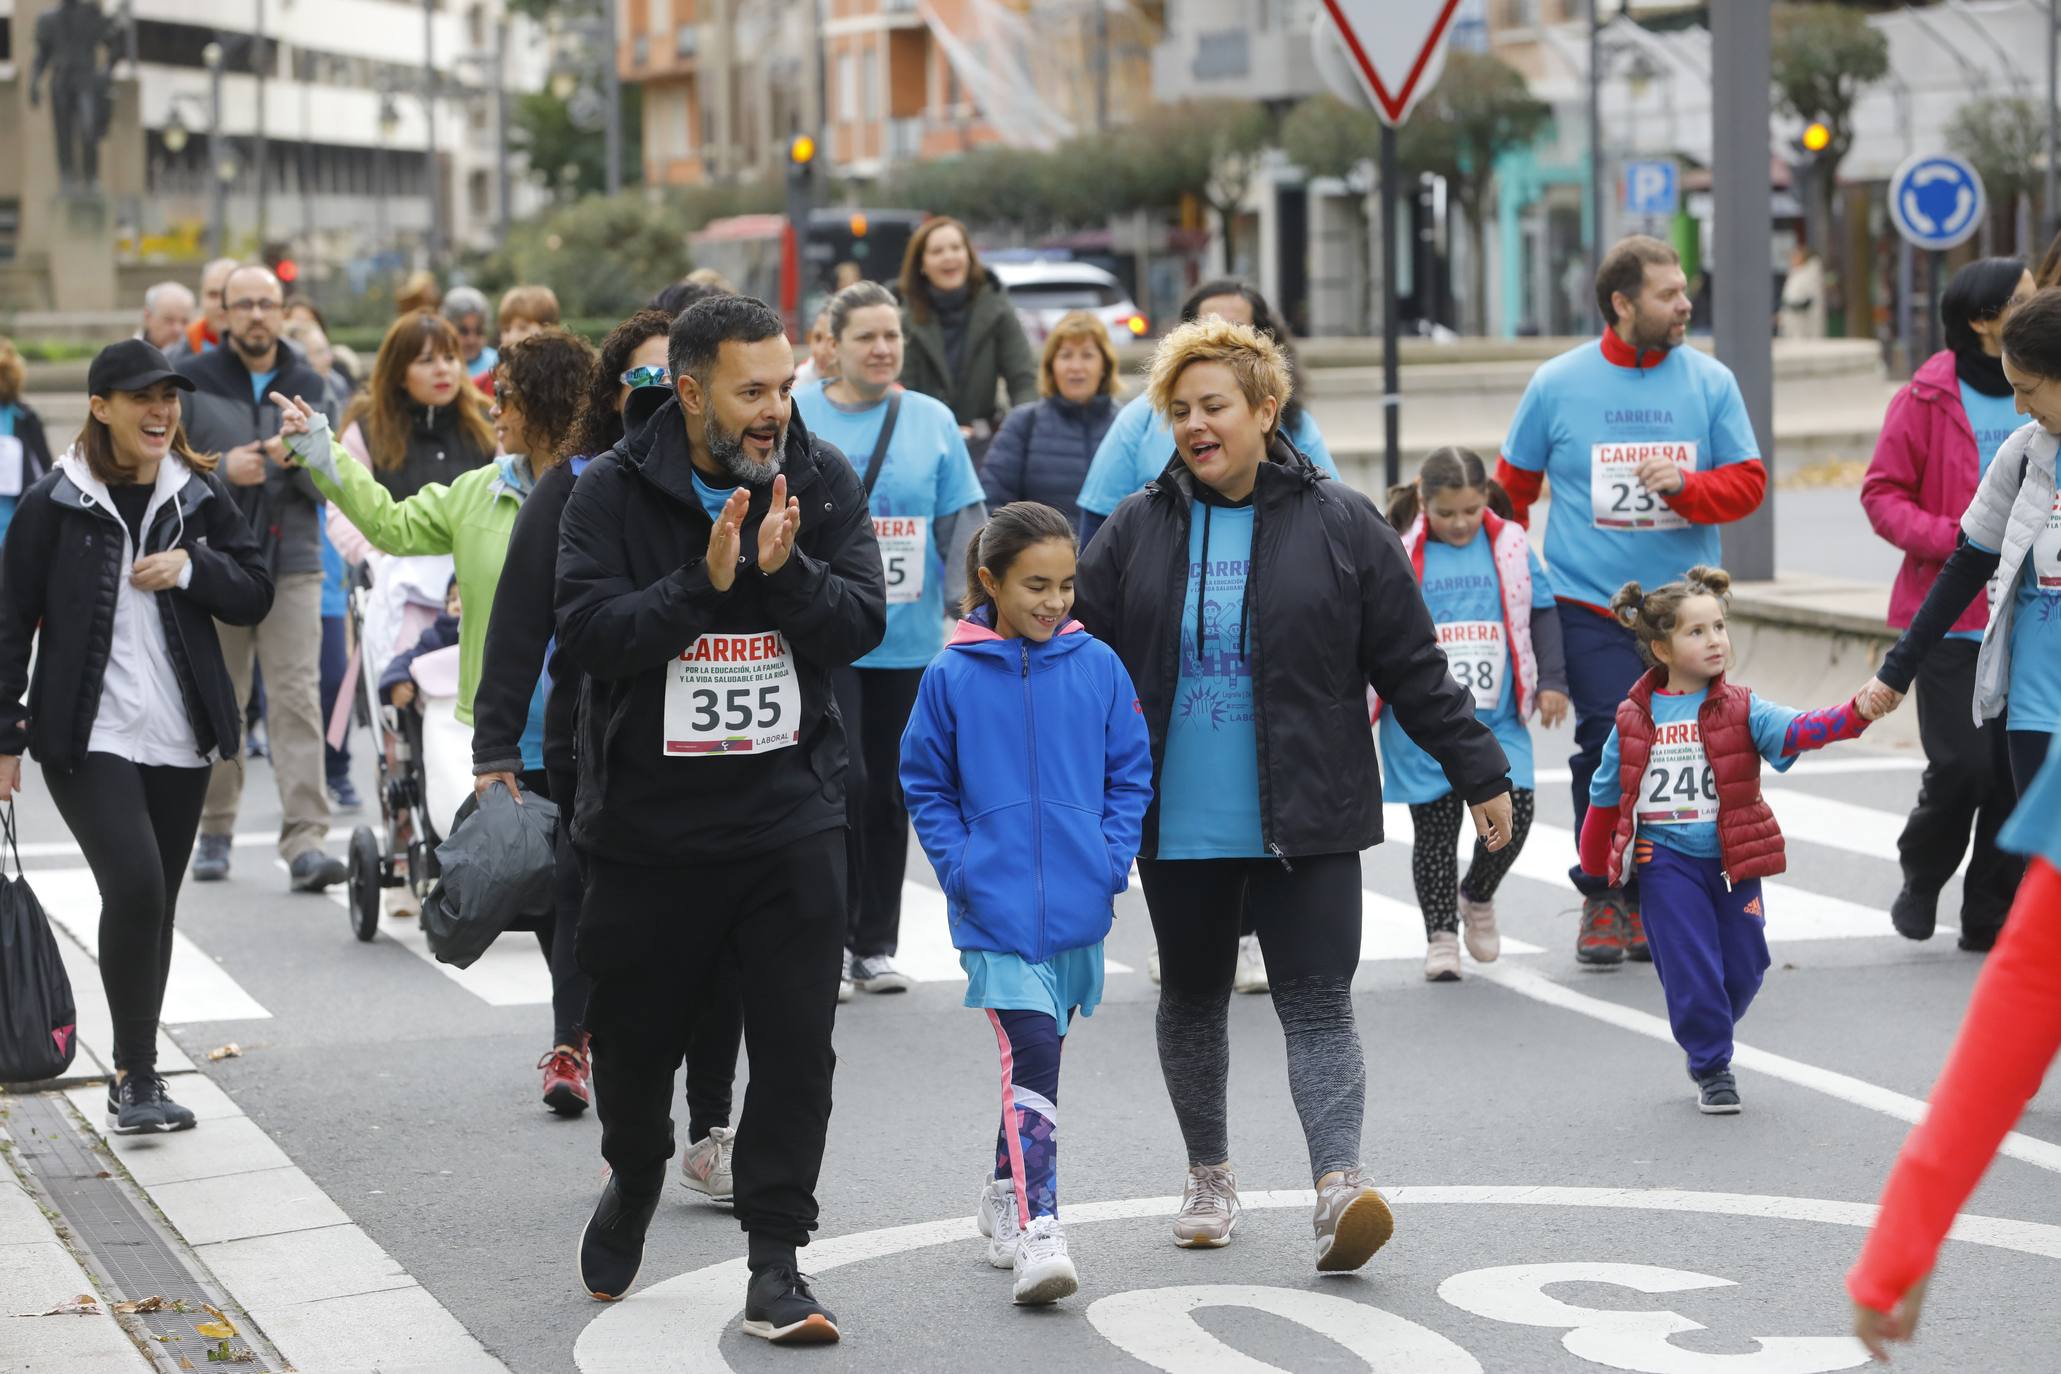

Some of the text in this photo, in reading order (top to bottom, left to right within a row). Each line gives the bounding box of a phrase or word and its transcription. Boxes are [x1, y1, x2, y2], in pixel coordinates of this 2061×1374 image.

[1634, 165, 1665, 208] P
[1604, 410, 1673, 424] CARRERA
[1600, 446, 1688, 463] CARRERA
[1424, 575, 1493, 593] CARRERA
[1437, 625, 1500, 643] RRERA
[679, 635, 786, 661] CARRERA
[685, 666, 699, 674] POR
[710, 664, 751, 674] EDUCACIÓN,
[753, 664, 762, 673] LA
[763, 661, 785, 672] FAMILIA
[714, 674, 754, 683] SALUDABLE
[755, 673, 764, 681] DE
[765, 672, 773, 680] LA
[774, 669, 789, 679] RIOJA
[691, 685, 782, 732] 355
[756, 733, 789, 746] LABORAL
[1649, 766, 1718, 803] 246
